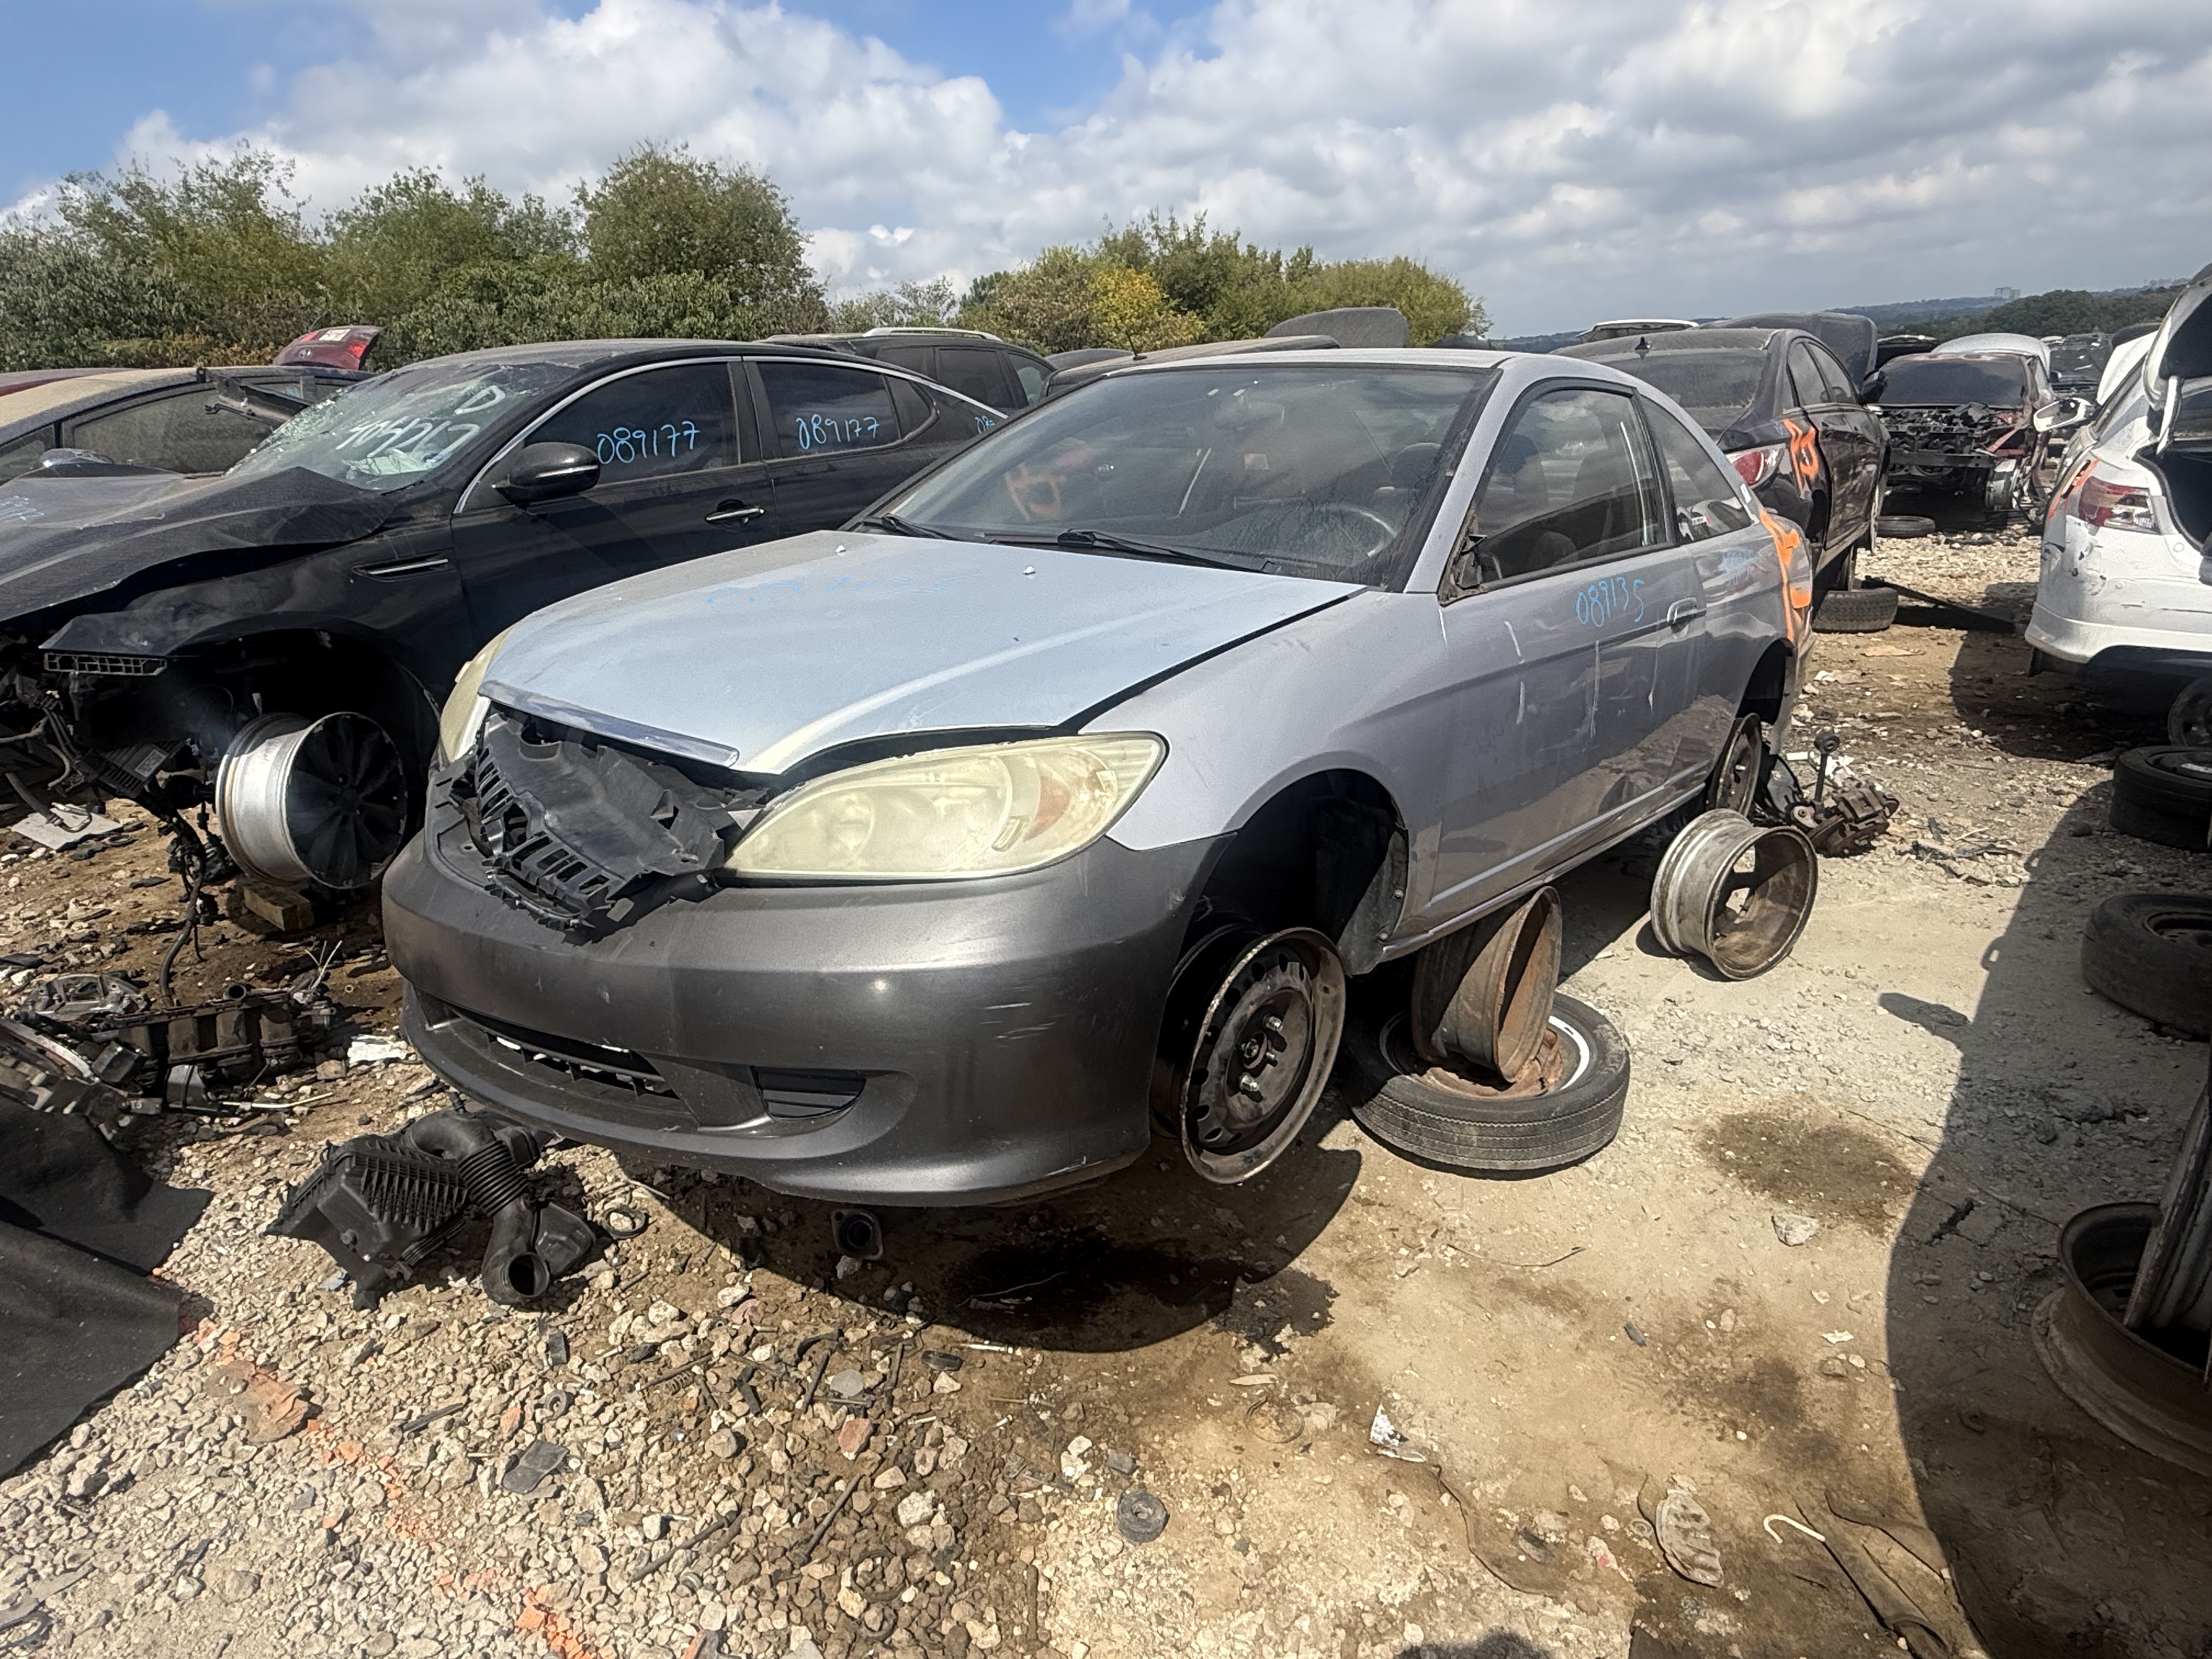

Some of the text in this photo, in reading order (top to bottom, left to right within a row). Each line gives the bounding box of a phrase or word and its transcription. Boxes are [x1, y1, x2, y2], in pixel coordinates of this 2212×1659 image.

[596, 420, 700, 464] 089177
[795, 414, 879, 450] 089177
[1575, 576, 1644, 627] 089135
